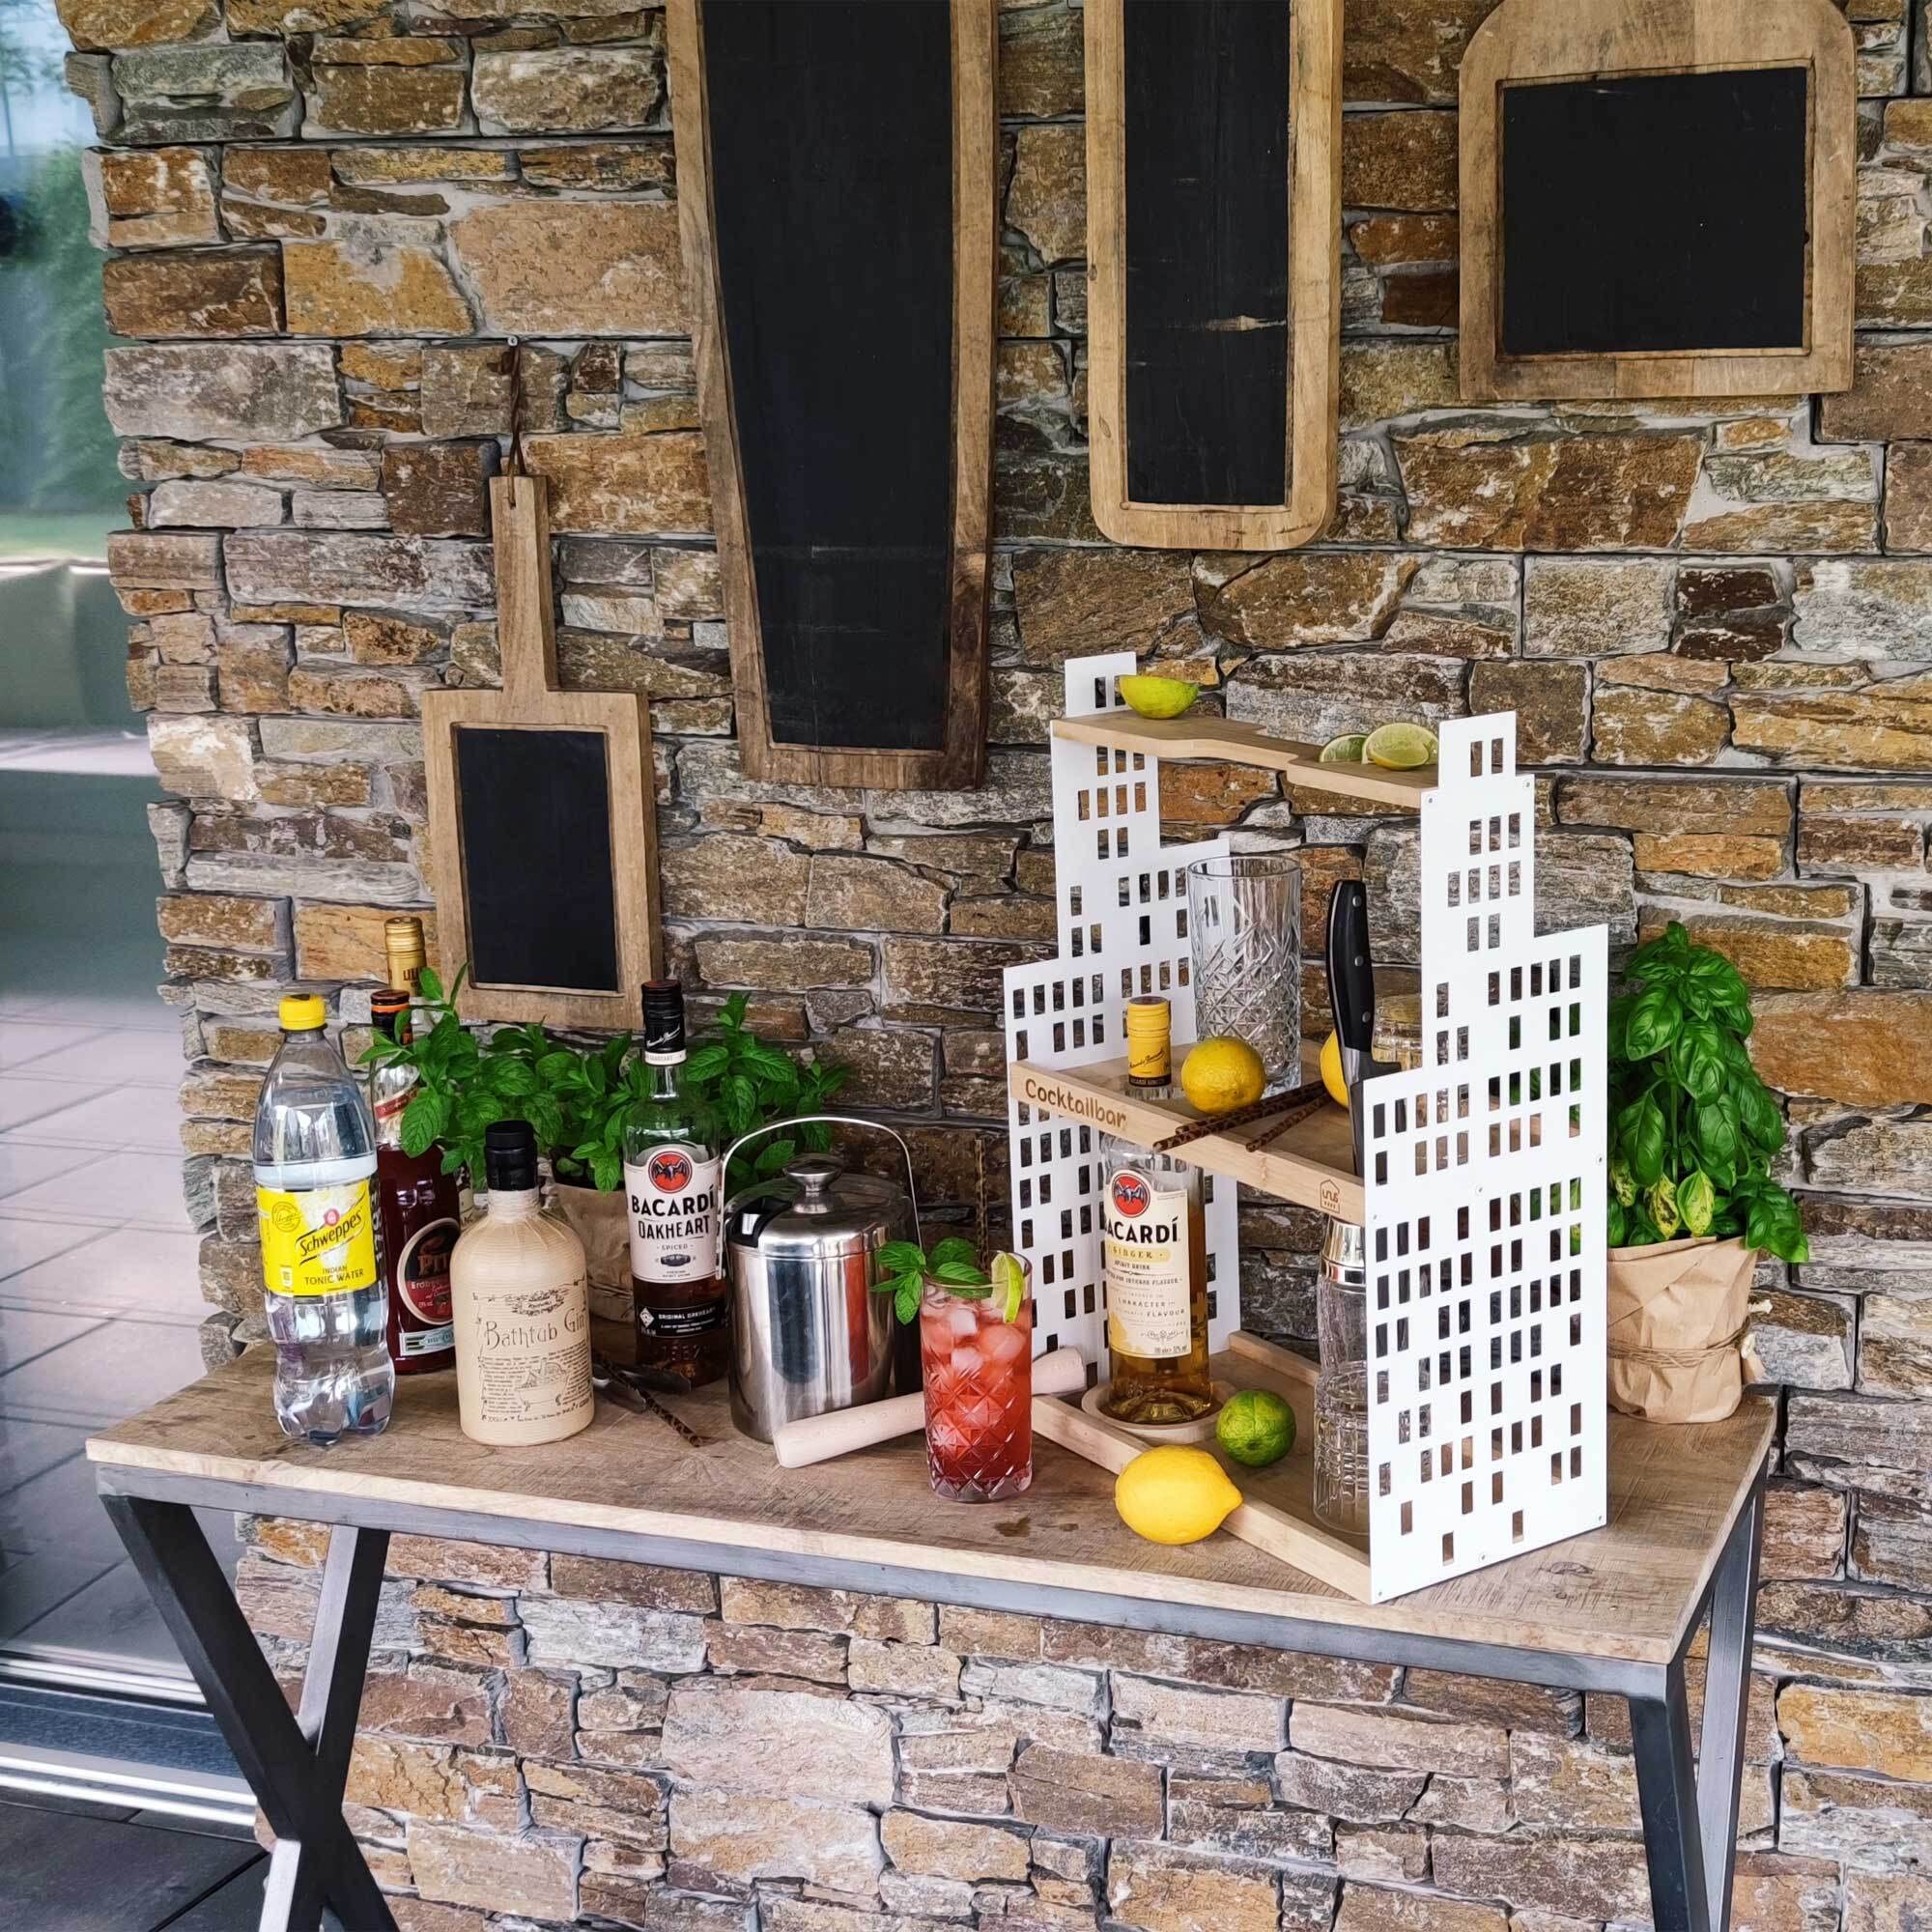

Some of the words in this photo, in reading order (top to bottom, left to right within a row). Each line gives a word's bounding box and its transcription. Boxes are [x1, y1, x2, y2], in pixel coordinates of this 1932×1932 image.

[1025, 1078, 1127, 1128] Cocktailbar
[631, 1183, 714, 1216] BACARDÍ
[299, 1209, 363, 1257] Schweppes
[638, 1214, 710, 1239] OAKHEART
[304, 1274, 334, 1286] TONIC
[336, 1267, 364, 1282] WATER
[485, 1321, 558, 1350] Bathtub
[563, 1307, 585, 1334] Gin
